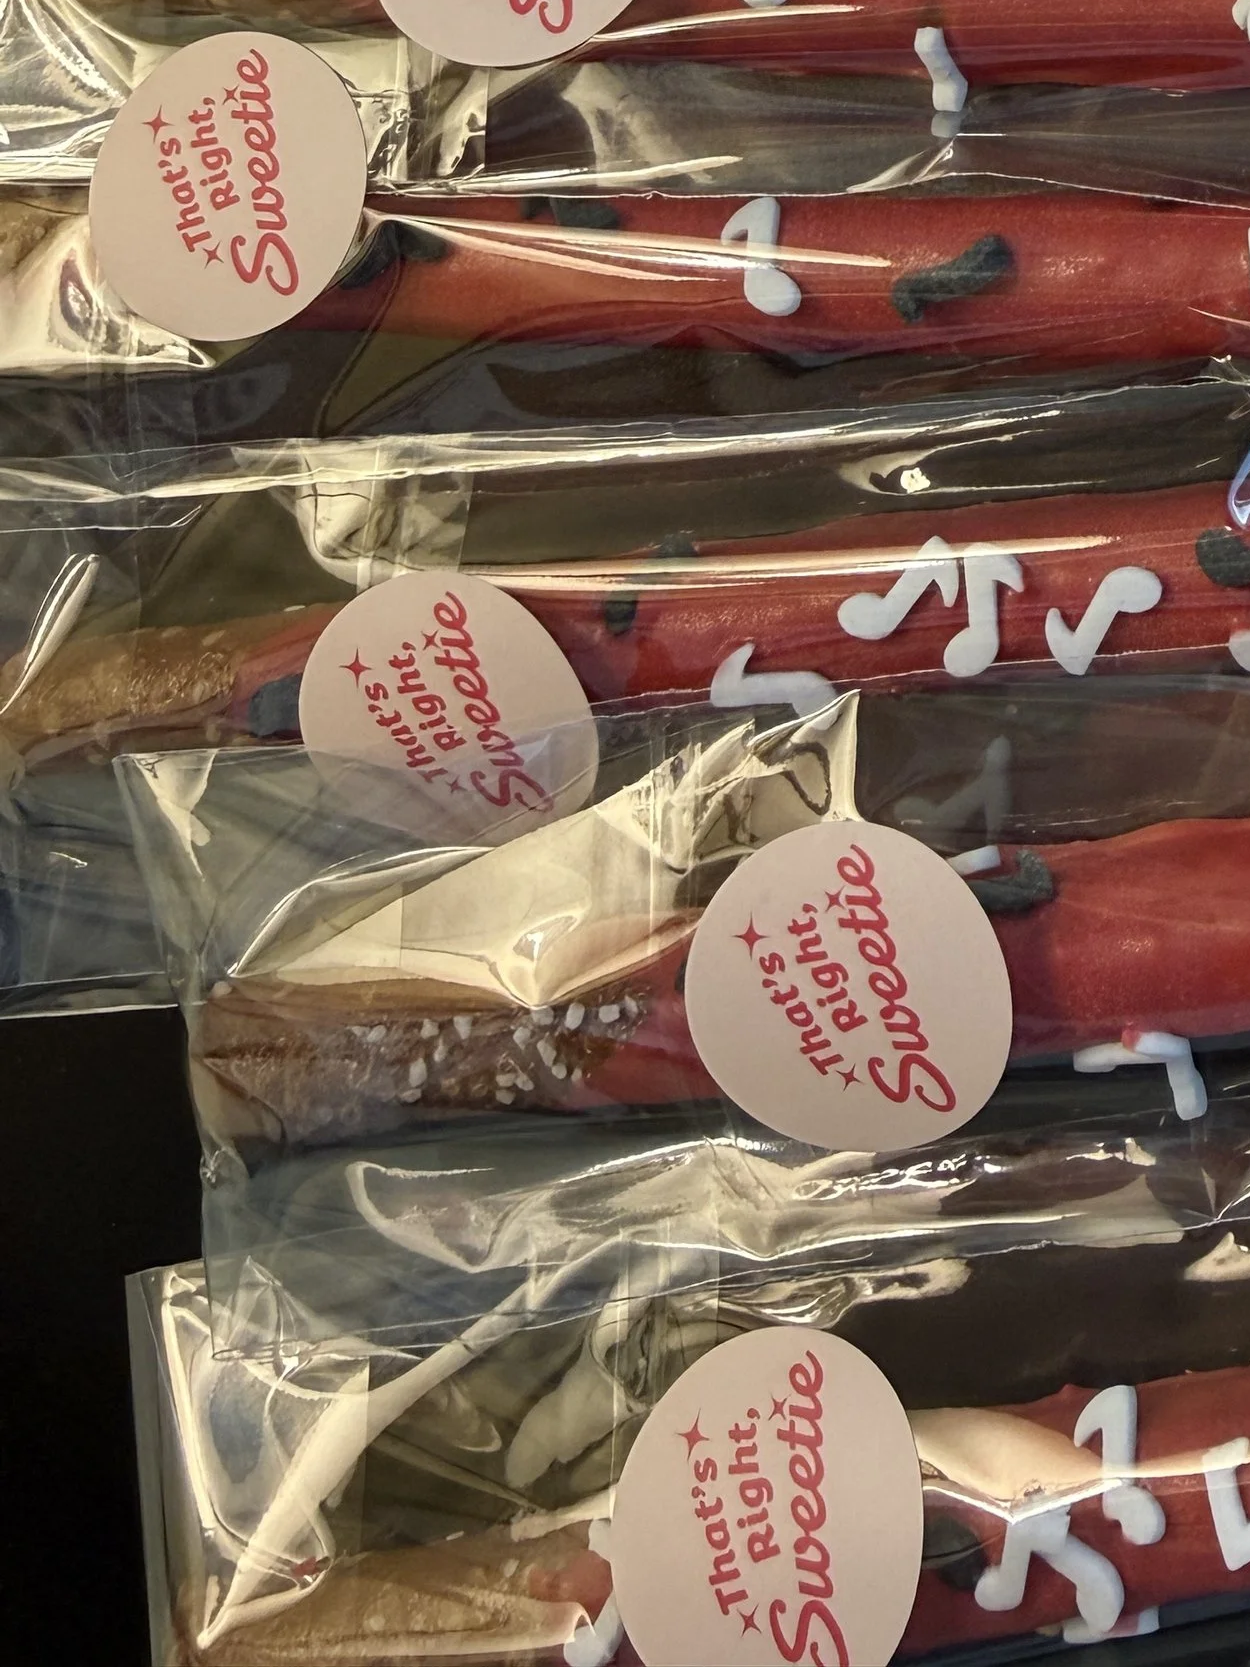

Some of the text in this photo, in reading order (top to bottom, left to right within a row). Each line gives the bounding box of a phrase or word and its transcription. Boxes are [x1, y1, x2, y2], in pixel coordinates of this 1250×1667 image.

[158, 137, 212, 253] That's
[188, 97, 240, 210] Right,
[230, 48, 299, 296] Sweetie
[389, 641, 467, 751] Right,
[433, 591, 554, 812] Sweetie
[759, 952, 844, 1075] That's
[787, 903, 868, 1032] Right,
[836, 844, 956, 1112] Sweetie
[691, 1457, 748, 1615] That's
[728, 1407, 781, 1563] Right,
[769, 1350, 849, 1667] Sweetie
